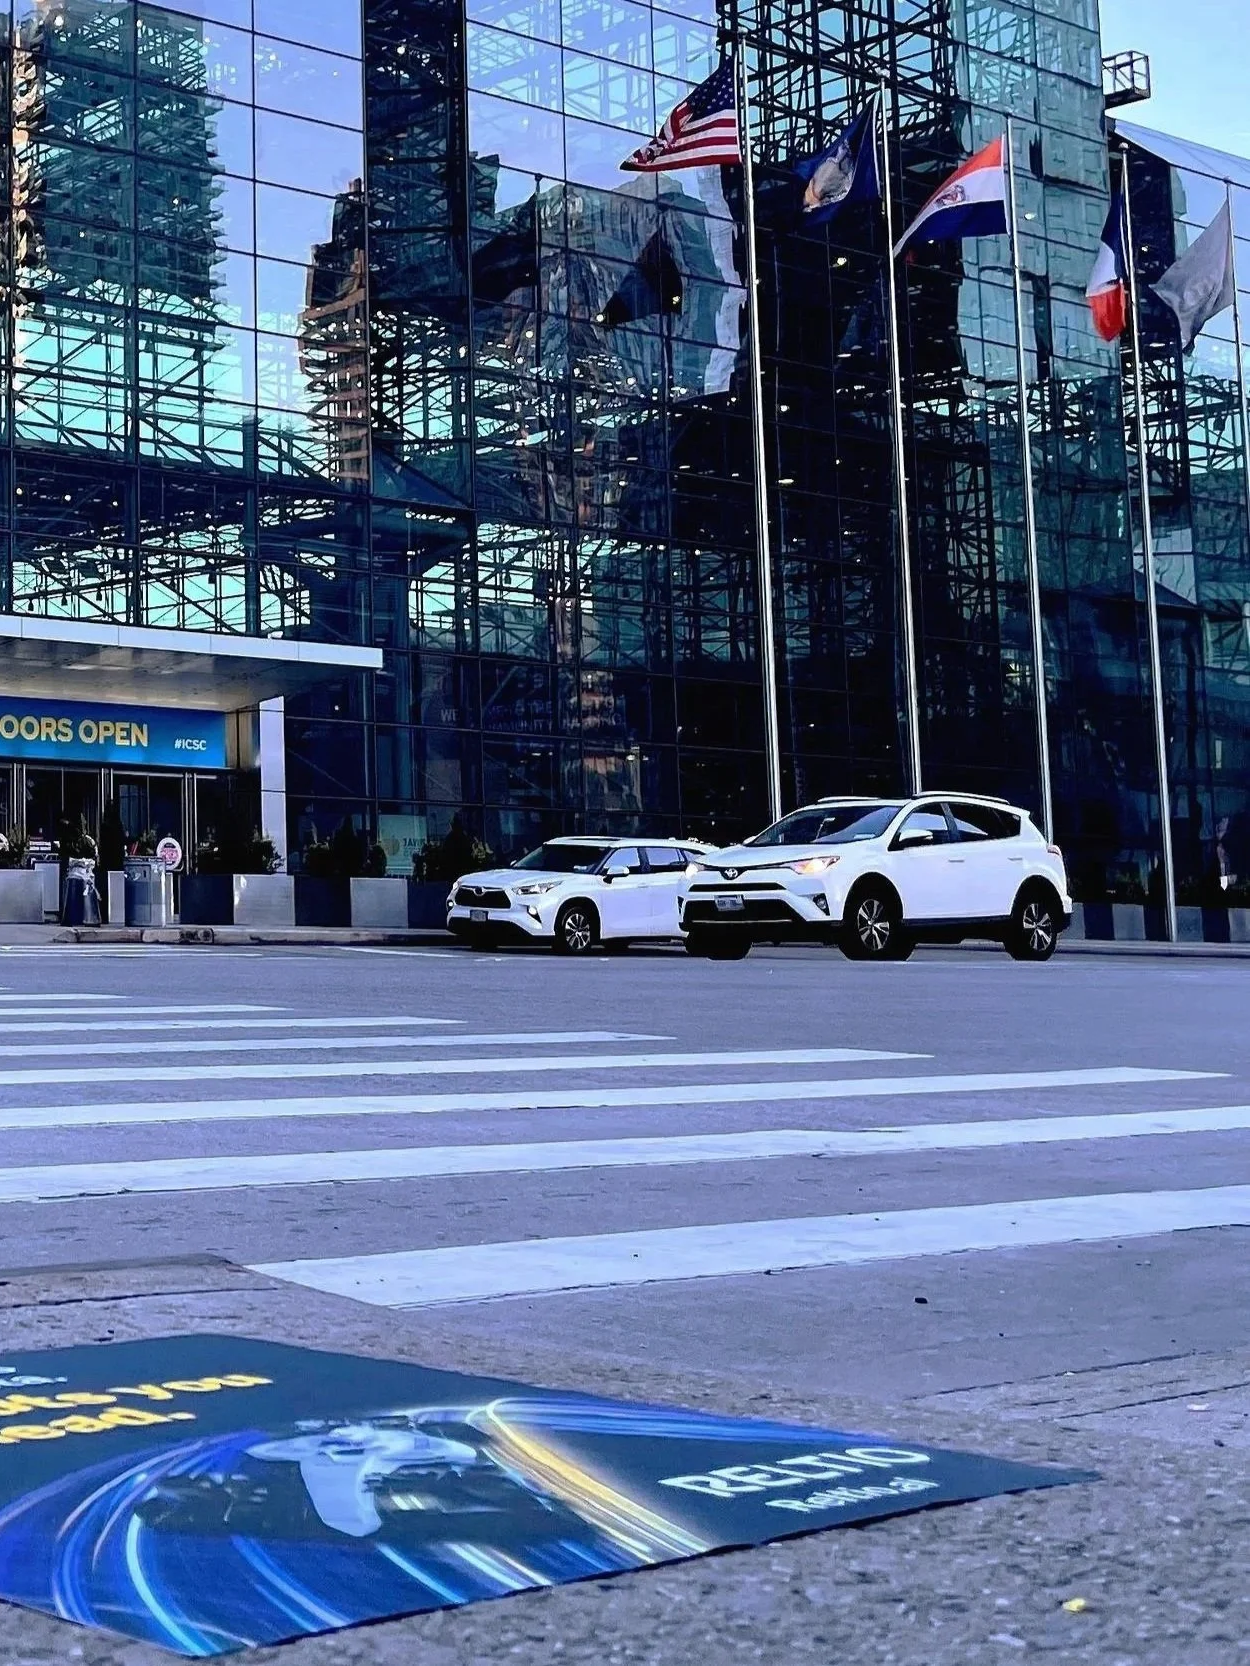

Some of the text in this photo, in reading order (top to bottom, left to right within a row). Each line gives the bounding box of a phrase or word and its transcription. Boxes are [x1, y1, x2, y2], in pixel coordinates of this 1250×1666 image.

[78, 719, 148, 747] OPEN
[174, 738, 207, 751] #ICSC
[105, 1373, 274, 1401] you
[657, 1447, 930, 1498] RELTIO
[764, 1476, 940, 1513] Reltio.ai
